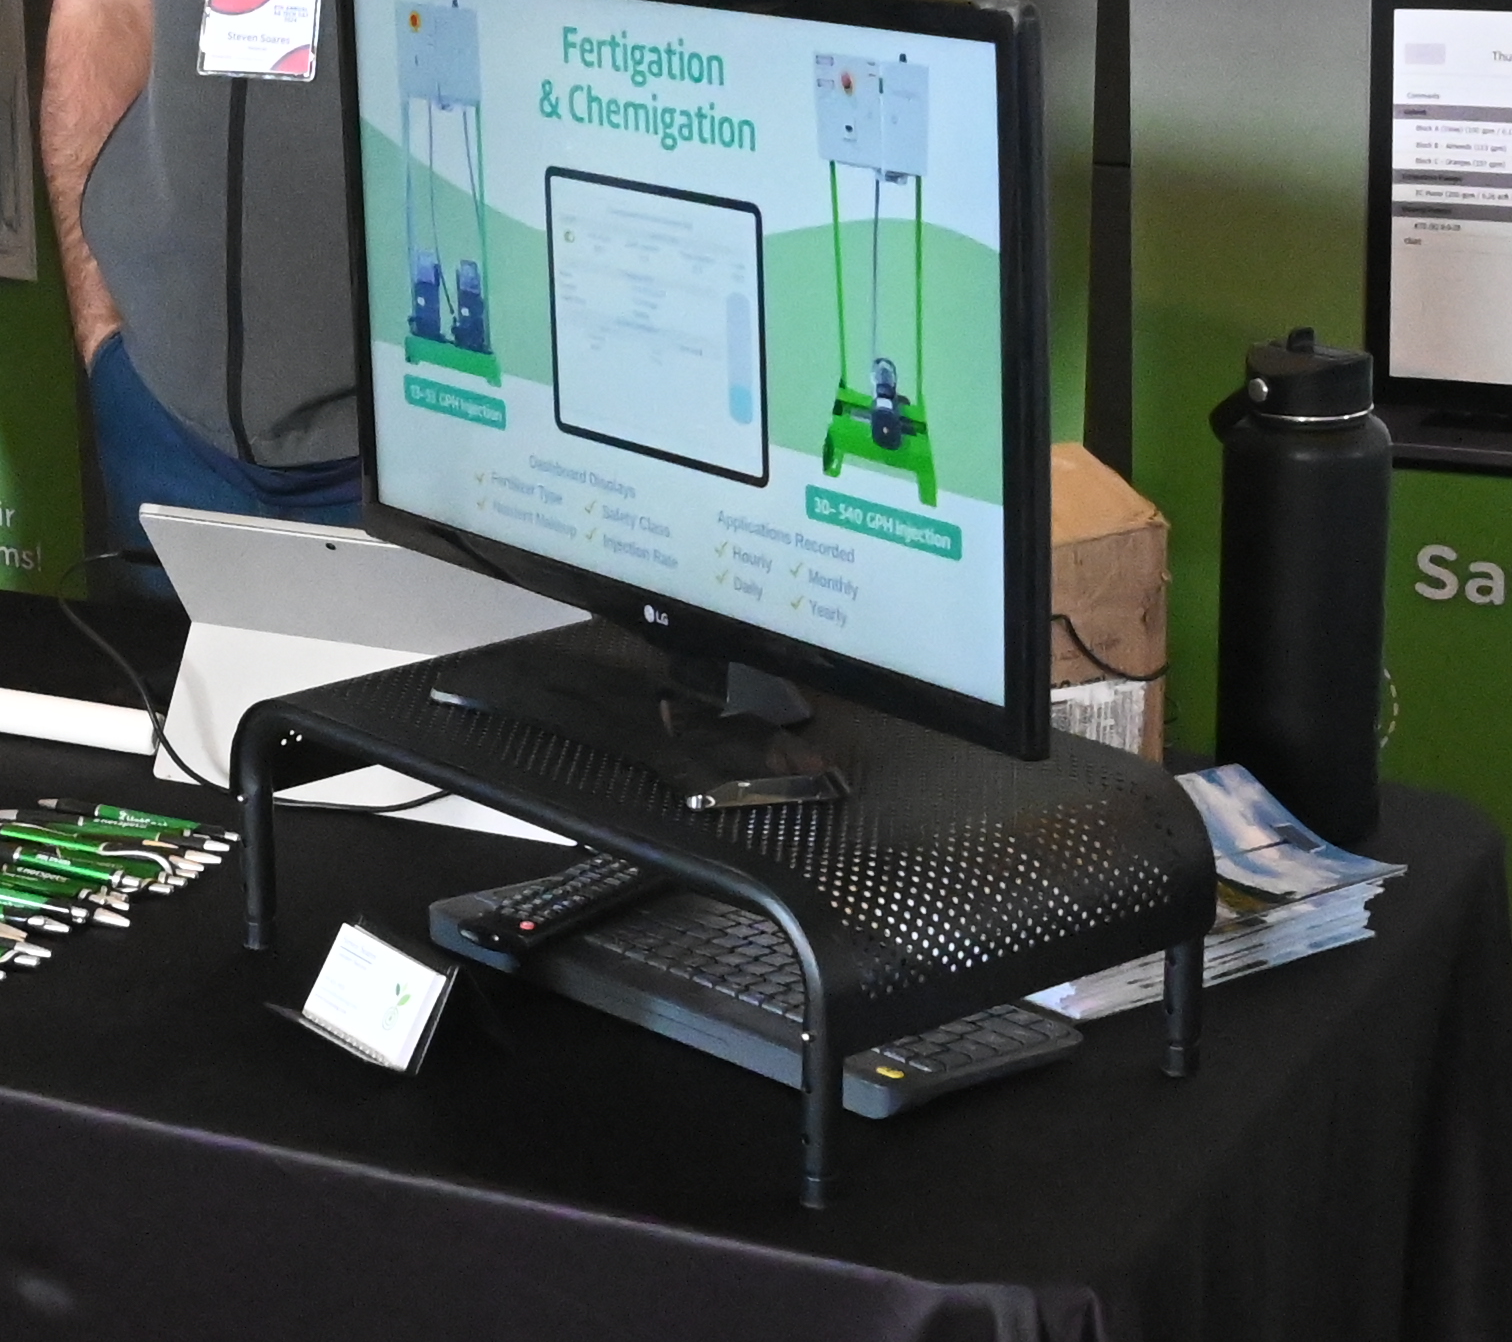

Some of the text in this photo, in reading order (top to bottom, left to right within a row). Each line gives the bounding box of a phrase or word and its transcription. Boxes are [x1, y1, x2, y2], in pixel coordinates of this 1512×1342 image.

[227, 31, 258, 43] Steven
[562, 25, 725, 90] Fertigation
[538, 78, 758, 153] & Chemigation
[529, 455, 636, 500] Dashboard Displays
[640, 516, 670, 538] Class
[718, 510, 856, 564] Applications Recorded
[866, 512, 893, 534] GPH
[895, 519, 952, 550] Injection
[733, 545, 773, 574] Hourly
[734, 576, 763, 601] Daily
[809, 569, 859, 601] Monthly
[655, 610, 669, 627] LG
[809, 599, 847, 628] Yearly
